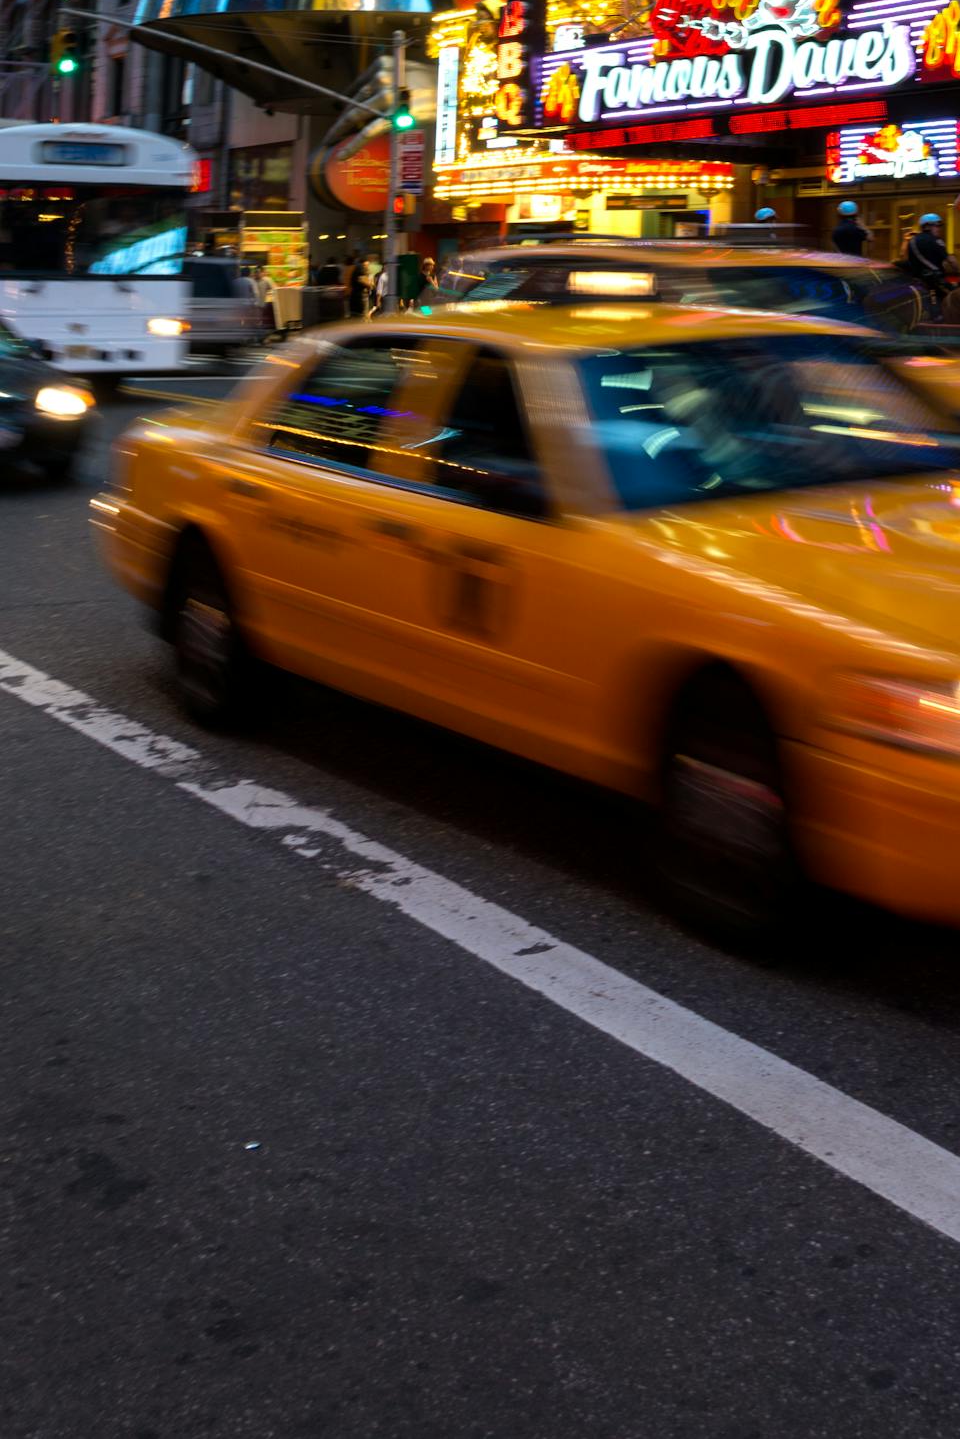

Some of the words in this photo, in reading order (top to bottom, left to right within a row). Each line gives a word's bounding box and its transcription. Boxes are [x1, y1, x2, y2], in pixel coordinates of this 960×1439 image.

[495, 0, 525, 126] BBQ
[578, 49, 742, 122] Famous
[746, 22, 916, 104] Dave's
